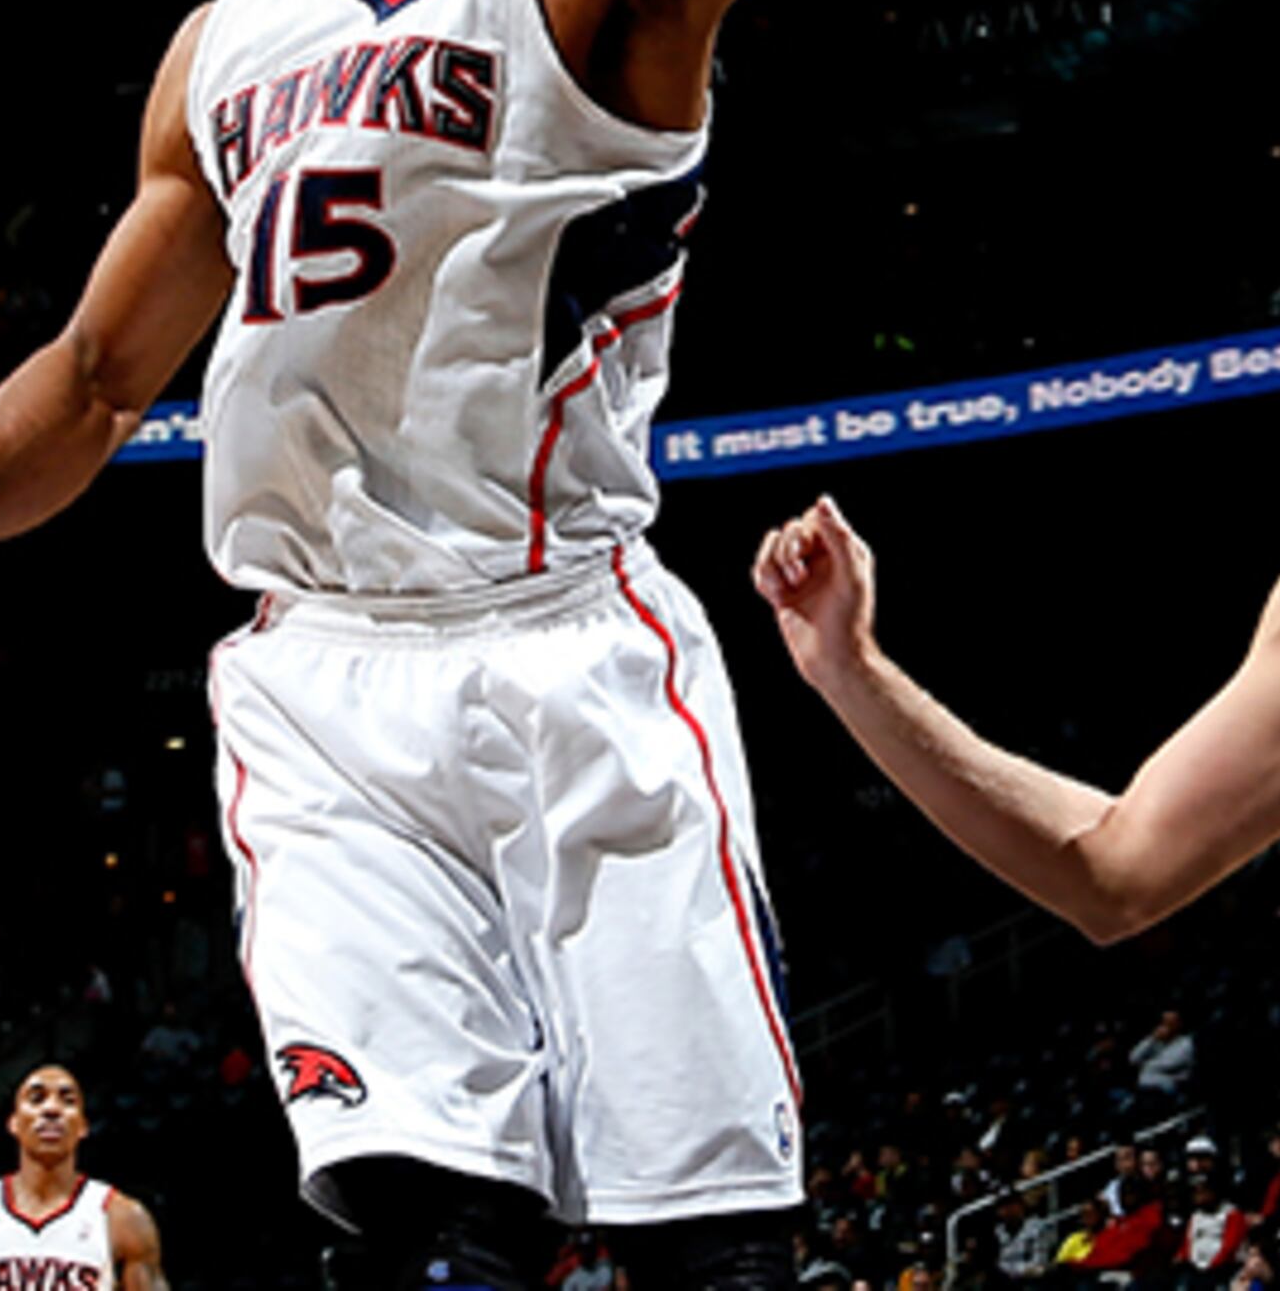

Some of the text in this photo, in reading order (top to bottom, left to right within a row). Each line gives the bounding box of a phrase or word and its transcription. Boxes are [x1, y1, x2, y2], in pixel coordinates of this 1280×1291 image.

[210, 36, 497, 200] HAWKS
[241, 167, 396, 324] 15
[665, 431, 703, 463] It
[712, 415, 827, 457] must
[835, 406, 896, 442] be
[906, 392, 1019, 431] true,
[1028, 358, 1199, 412] Nobody
